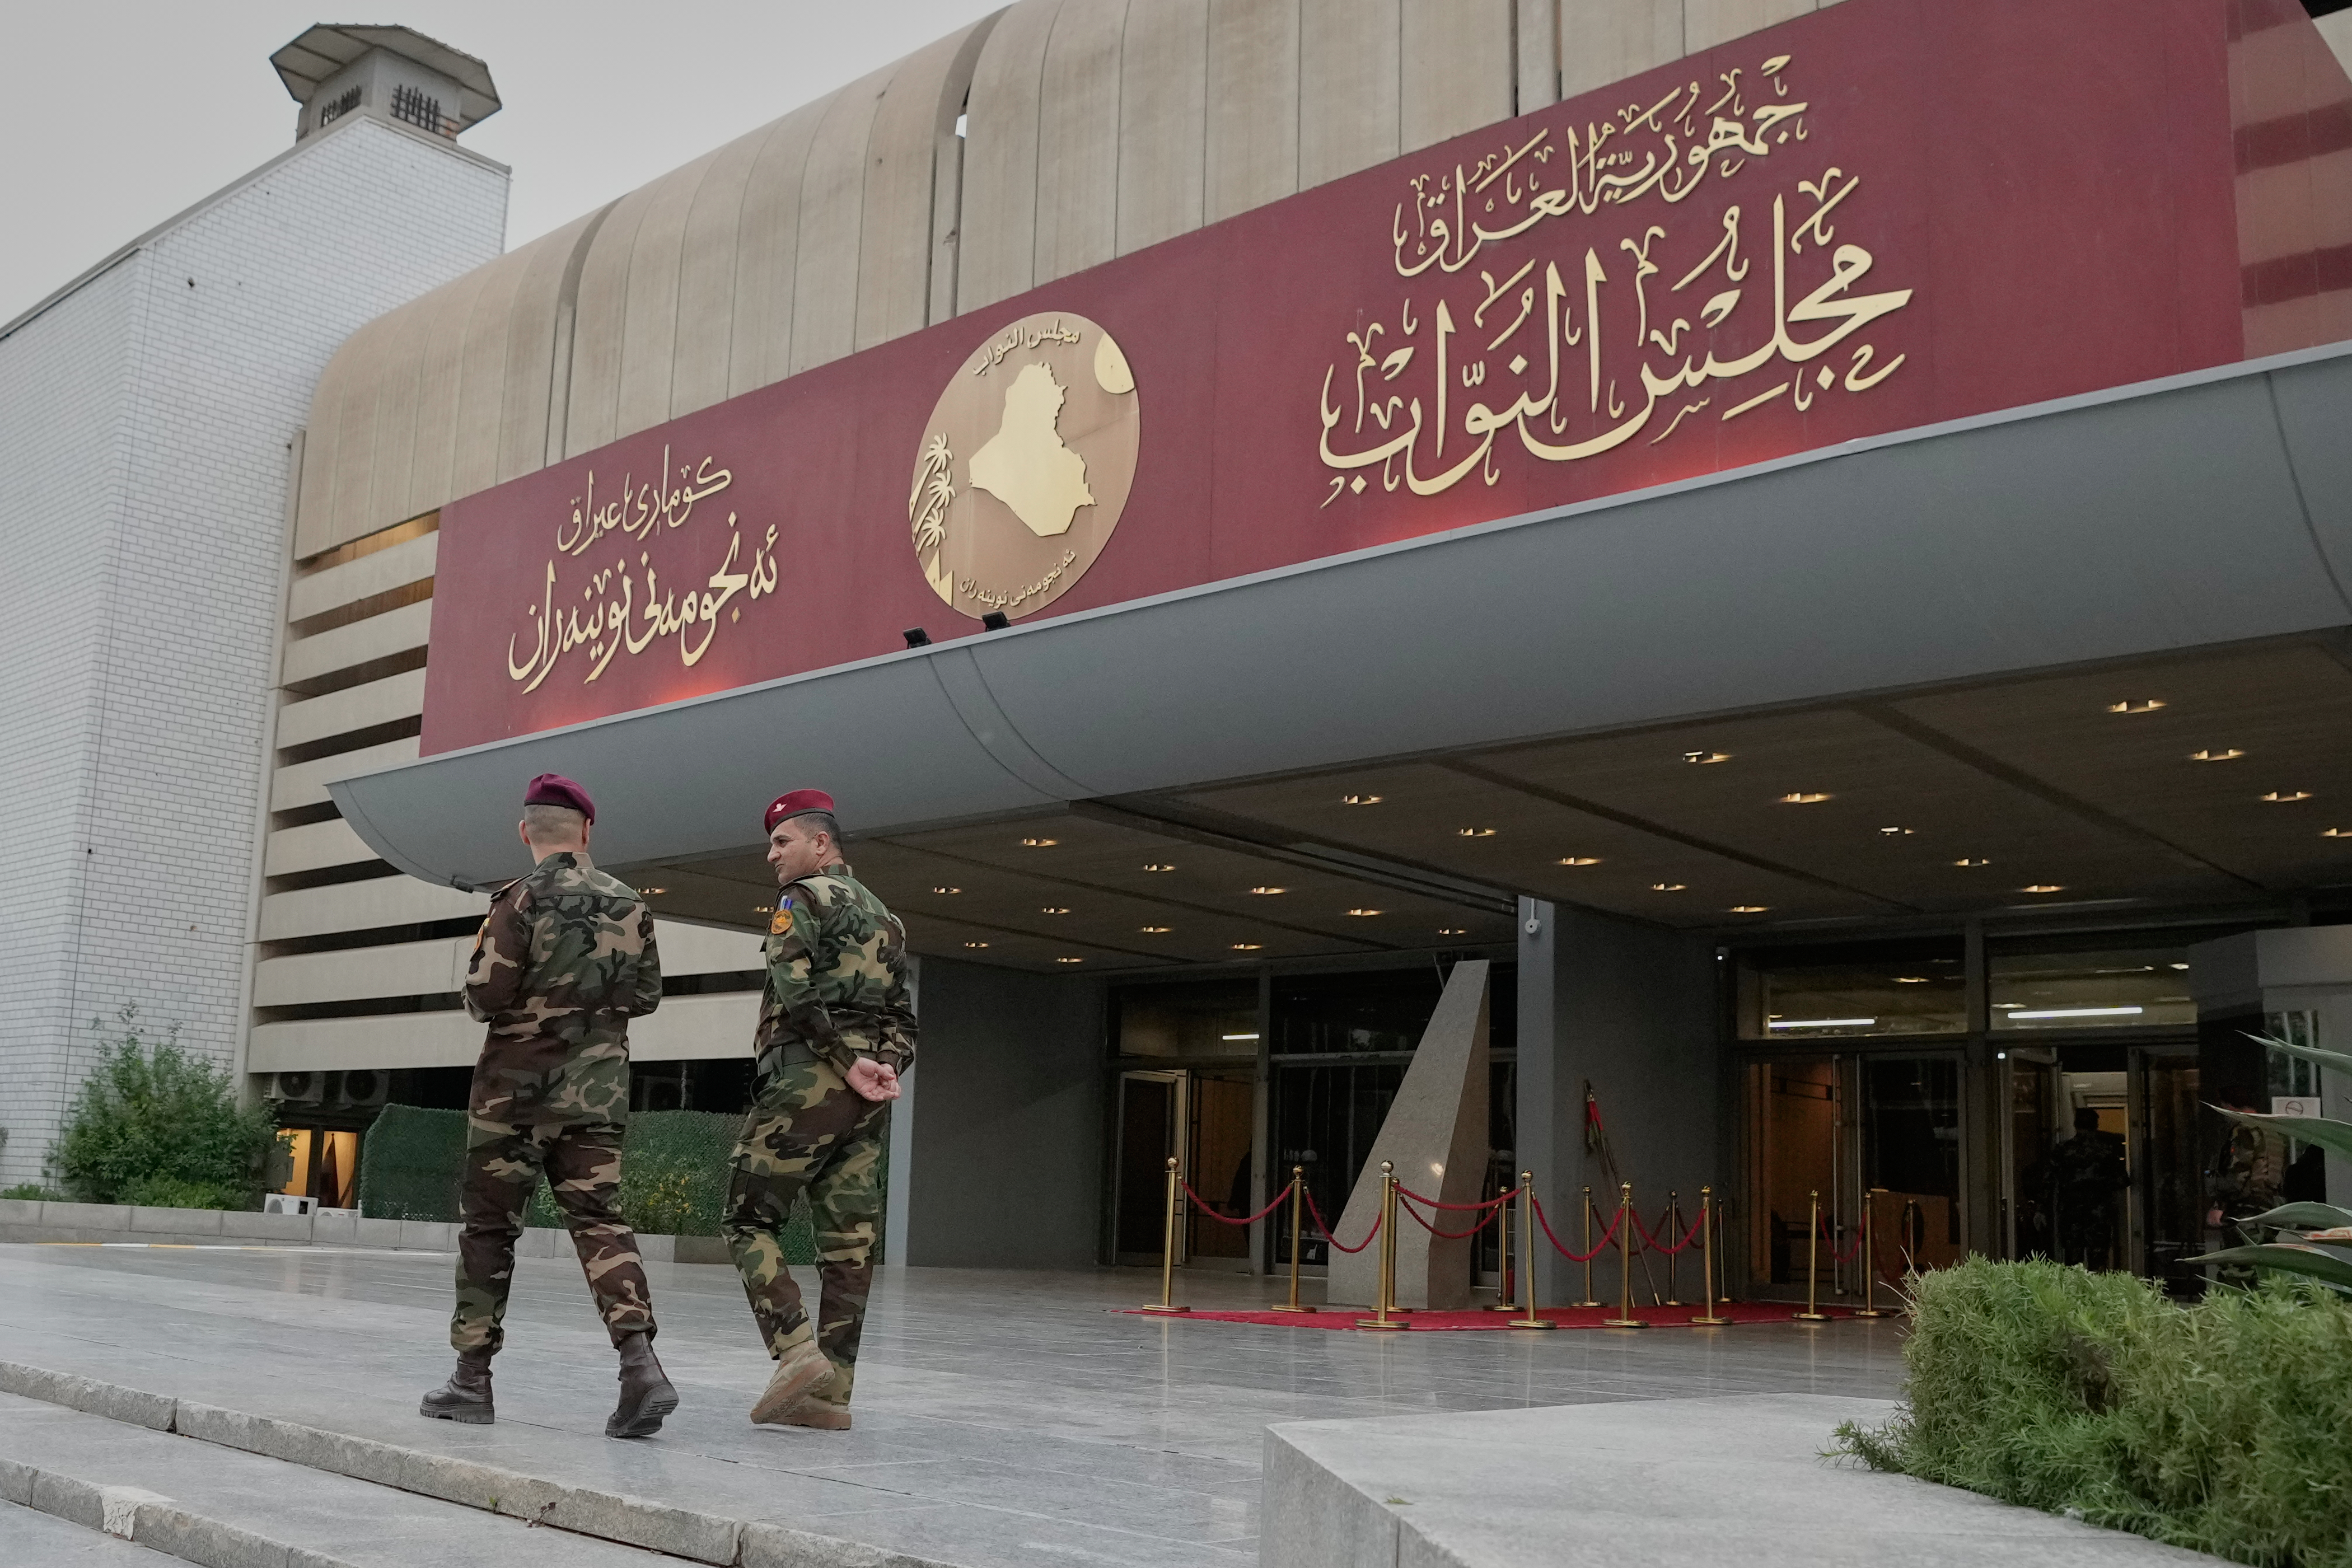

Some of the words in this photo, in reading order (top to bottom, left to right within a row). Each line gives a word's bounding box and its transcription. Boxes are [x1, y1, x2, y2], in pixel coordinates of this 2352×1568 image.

[1393, 121, 1596, 277] العراق
[972, 326, 1025, 377] النواب
[1027, 319, 1081, 350] مجلس
[1518, 167, 1913, 462] مجلس
